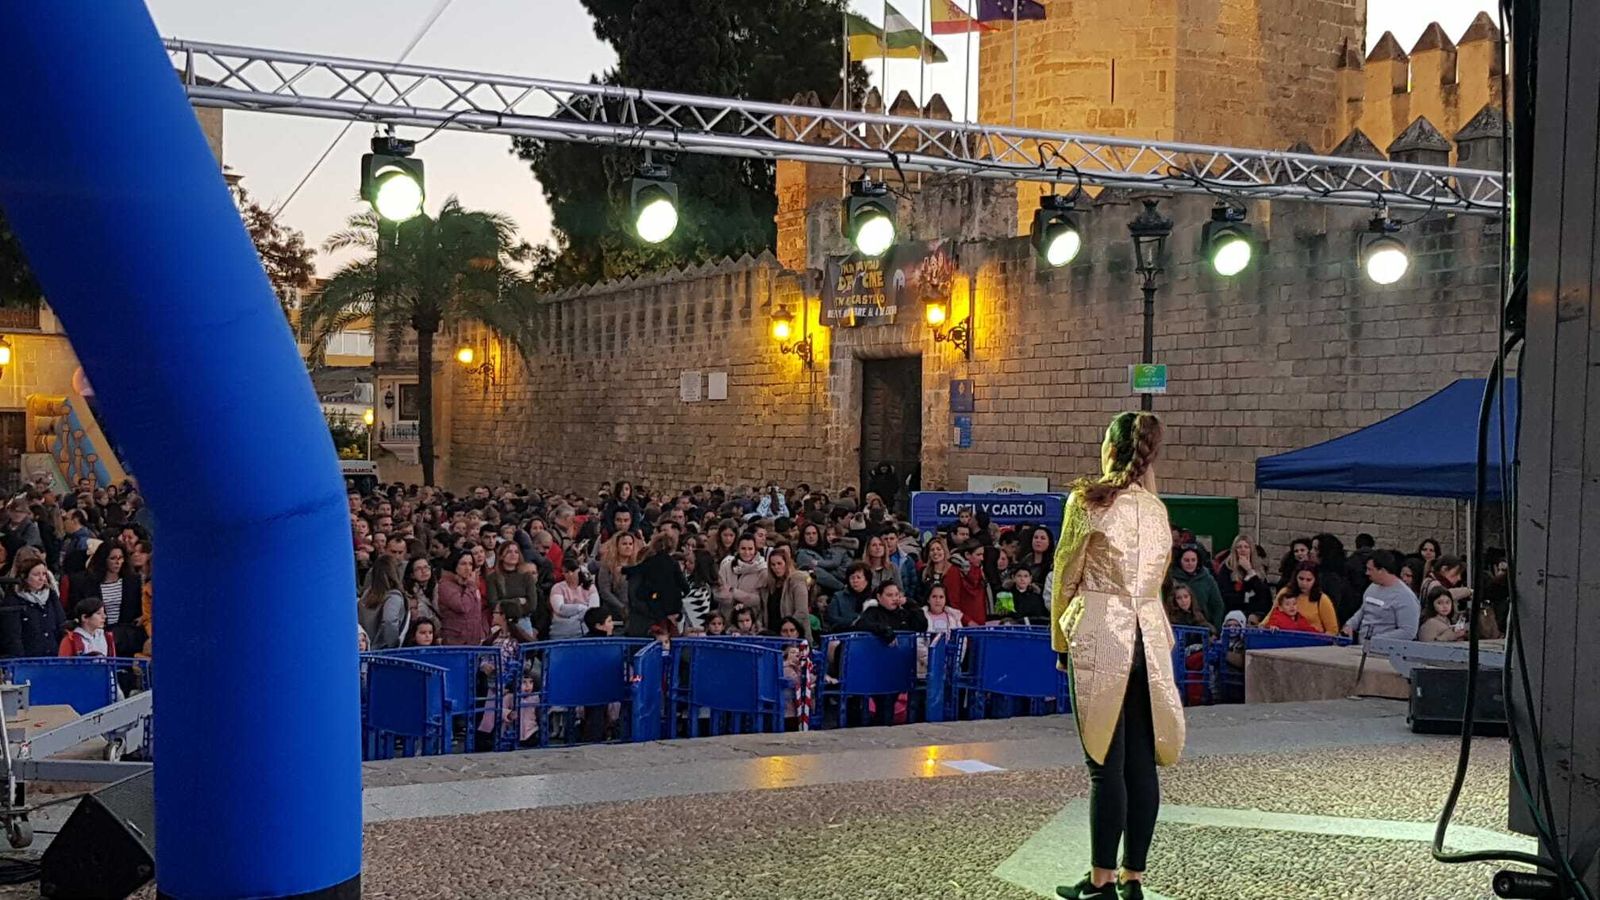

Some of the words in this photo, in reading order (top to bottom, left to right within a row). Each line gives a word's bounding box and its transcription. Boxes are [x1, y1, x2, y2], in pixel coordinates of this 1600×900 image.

[862, 271, 884, 288] CINE
[852, 294, 885, 304] CASTO
[940, 503, 977, 515] PAPL
[981, 503, 990, 513] Y
[992, 501, 1043, 515] CARTÓN
